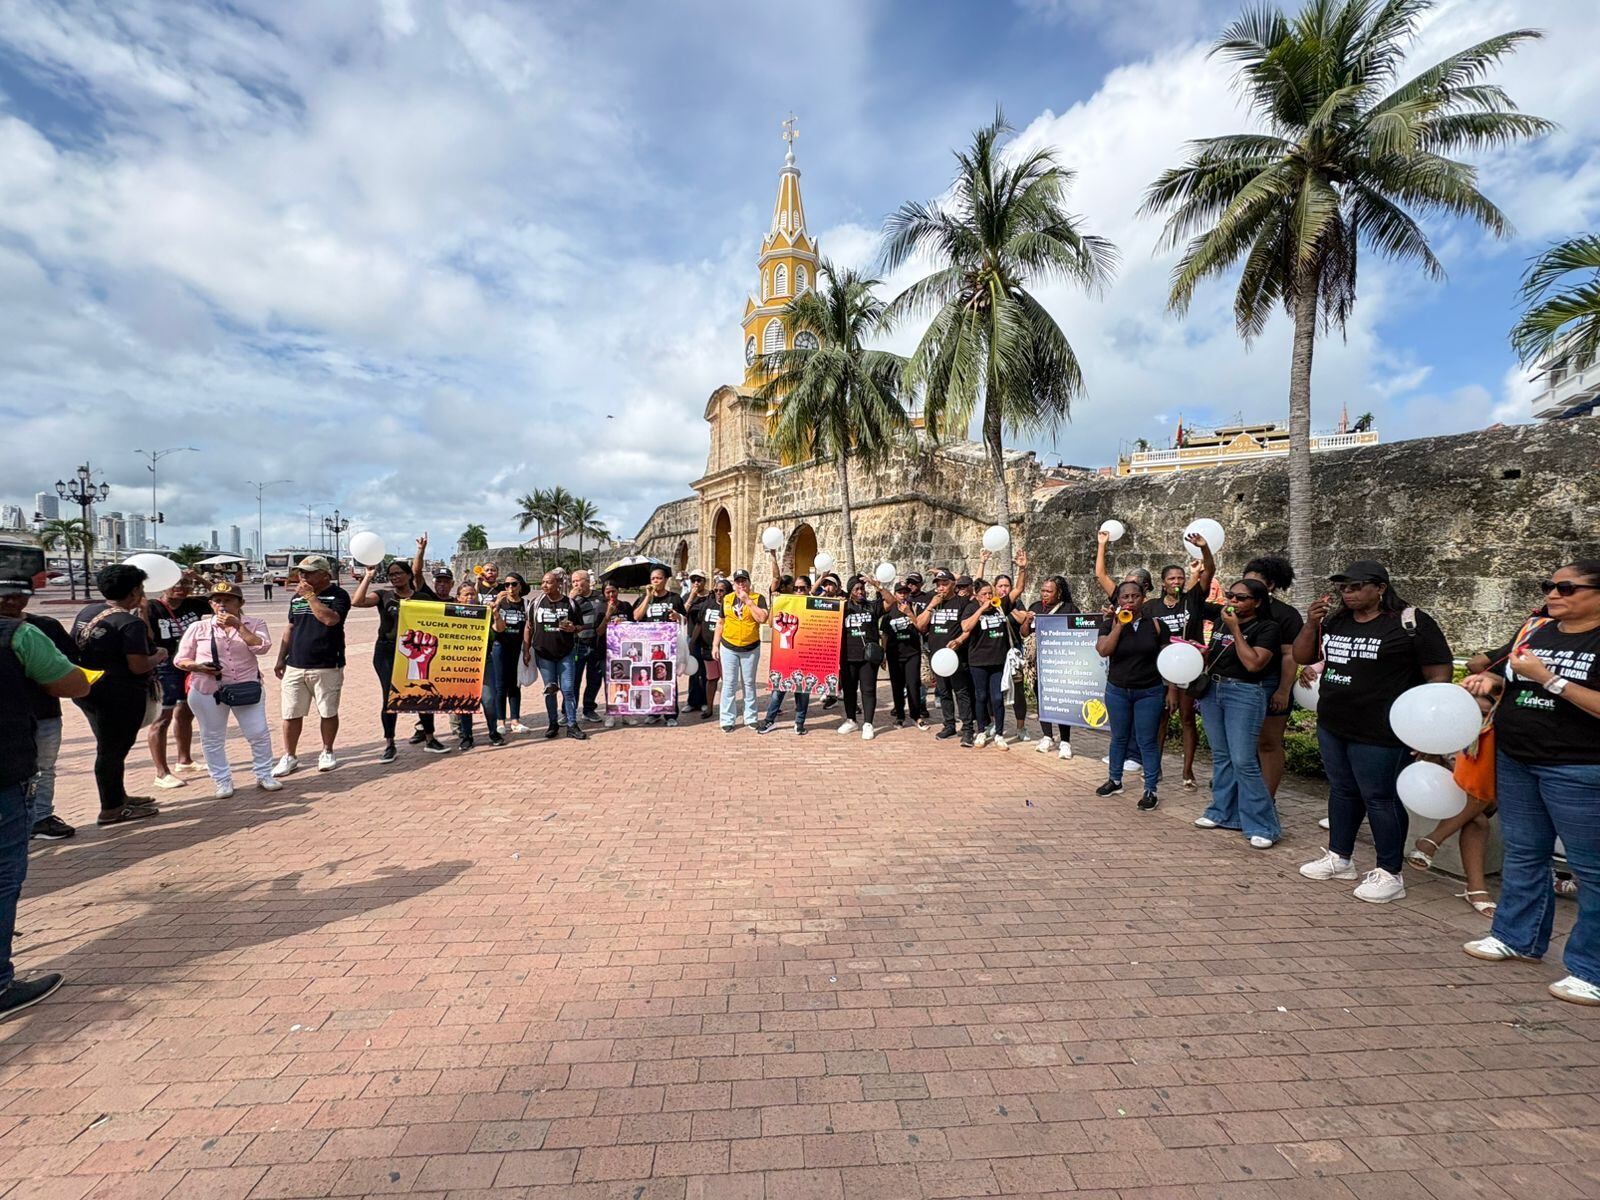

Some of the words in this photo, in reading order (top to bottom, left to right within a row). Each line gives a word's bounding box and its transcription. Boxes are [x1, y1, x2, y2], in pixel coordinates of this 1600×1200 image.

[417, 620, 449, 628] "LUCHA
[452, 622, 468, 630] POR
[438, 633, 484, 642] DERECHOS,
[1073, 630, 1090, 638] seguir
[1368, 637, 1382, 645] TUS
[1367, 644, 1380, 652] HAY
[1359, 651, 1378, 660] LUCHA
[1577, 652, 1596, 662] TUS
[1573, 660, 1592, 671] HAY
[1328, 673, 1352, 682] unicat
[1560, 667, 1588, 681] LUCHA
[434, 676, 480, 684] CONTINUA"
[1524, 696, 1555, 708] unicat
